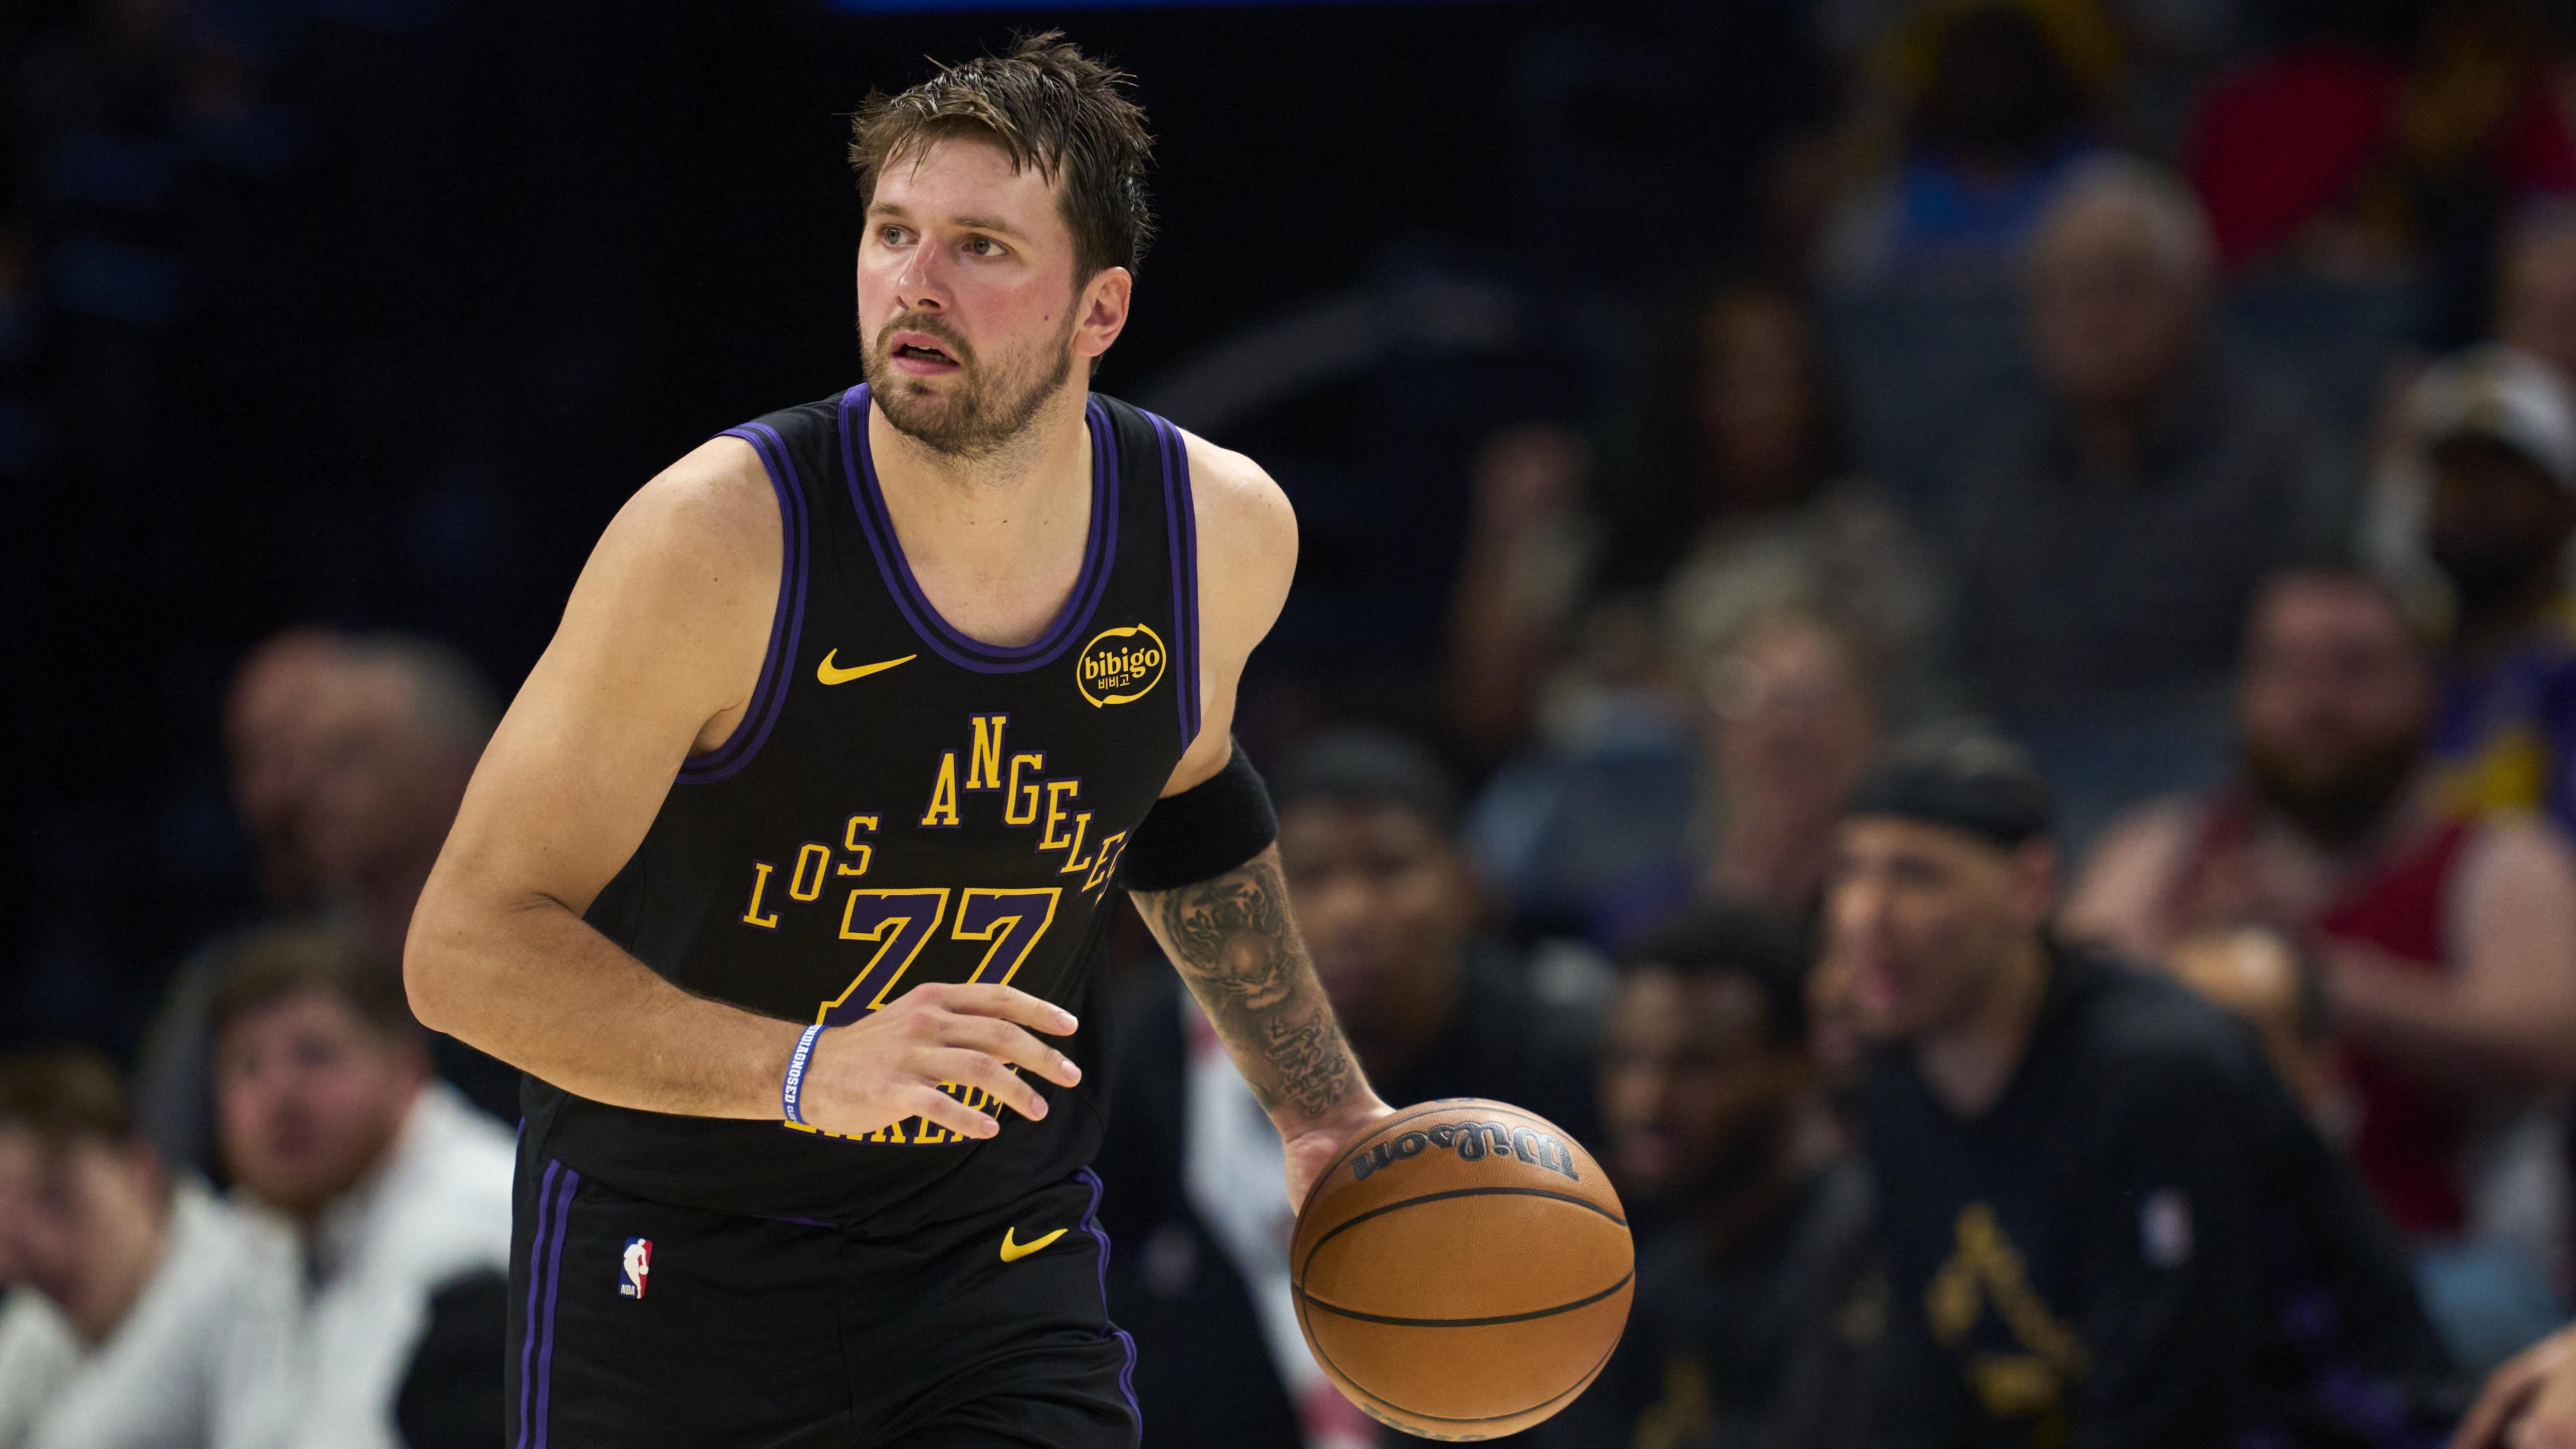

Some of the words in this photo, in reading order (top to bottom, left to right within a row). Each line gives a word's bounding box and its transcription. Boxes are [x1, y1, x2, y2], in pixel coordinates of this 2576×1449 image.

[1084, 646, 1160, 678] bibigo
[1098, 674, 1130, 690] 비비고
[741, 814, 880, 930] LOS
[816, 887, 1063, 1026] 77
[785, 1025, 822, 1103] UNDIAGNOSED
[1349, 1120, 1580, 1183] Wilson
[620, 1284, 635, 1296] NBA
